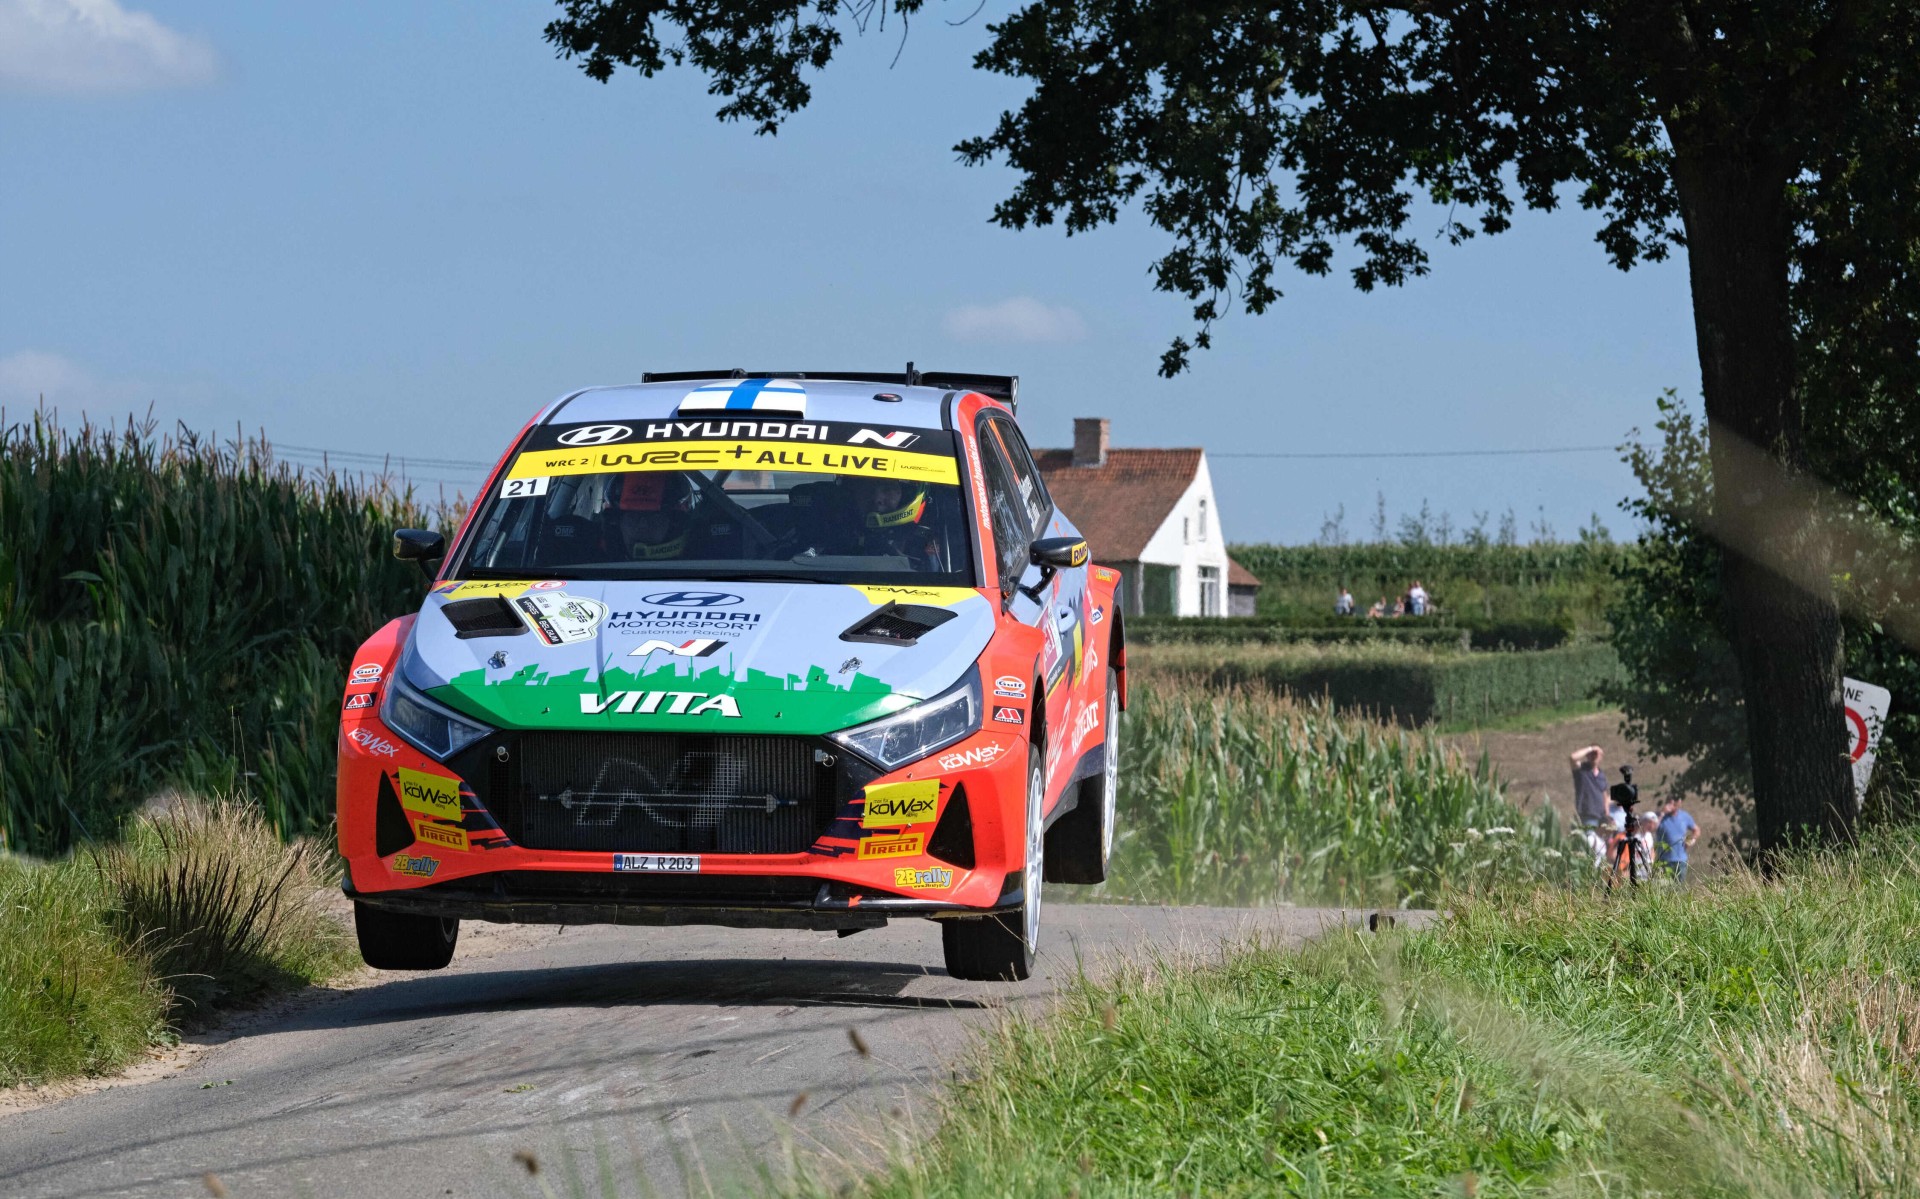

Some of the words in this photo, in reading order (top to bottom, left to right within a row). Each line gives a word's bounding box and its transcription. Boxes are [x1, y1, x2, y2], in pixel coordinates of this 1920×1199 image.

[646, 421, 829, 441] HYUNDAI
[545, 458, 577, 468] WRC
[580, 458, 589, 466] 2
[756, 450, 812, 466] ALL
[822, 453, 889, 472] LIVE
[507, 478, 538, 496] 21
[611, 610, 761, 623] HYUNDAI
[607, 620, 758, 631] MOTORSPORT
[692, 629, 741, 638] Racing
[356, 667, 379, 675] Gulf
[998, 680, 1023, 688] Gulf
[1844, 687, 1864, 703] NE
[579, 690, 742, 718] VIITA
[418, 823, 463, 846] PIRELLI
[863, 837, 919, 855] PIRELLI
[393, 854, 440, 877] 2Brally
[623, 856, 649, 870] ALZ
[657, 857, 666, 870] R
[668, 857, 693, 871] 203
[895, 867, 952, 887] 2Brally
